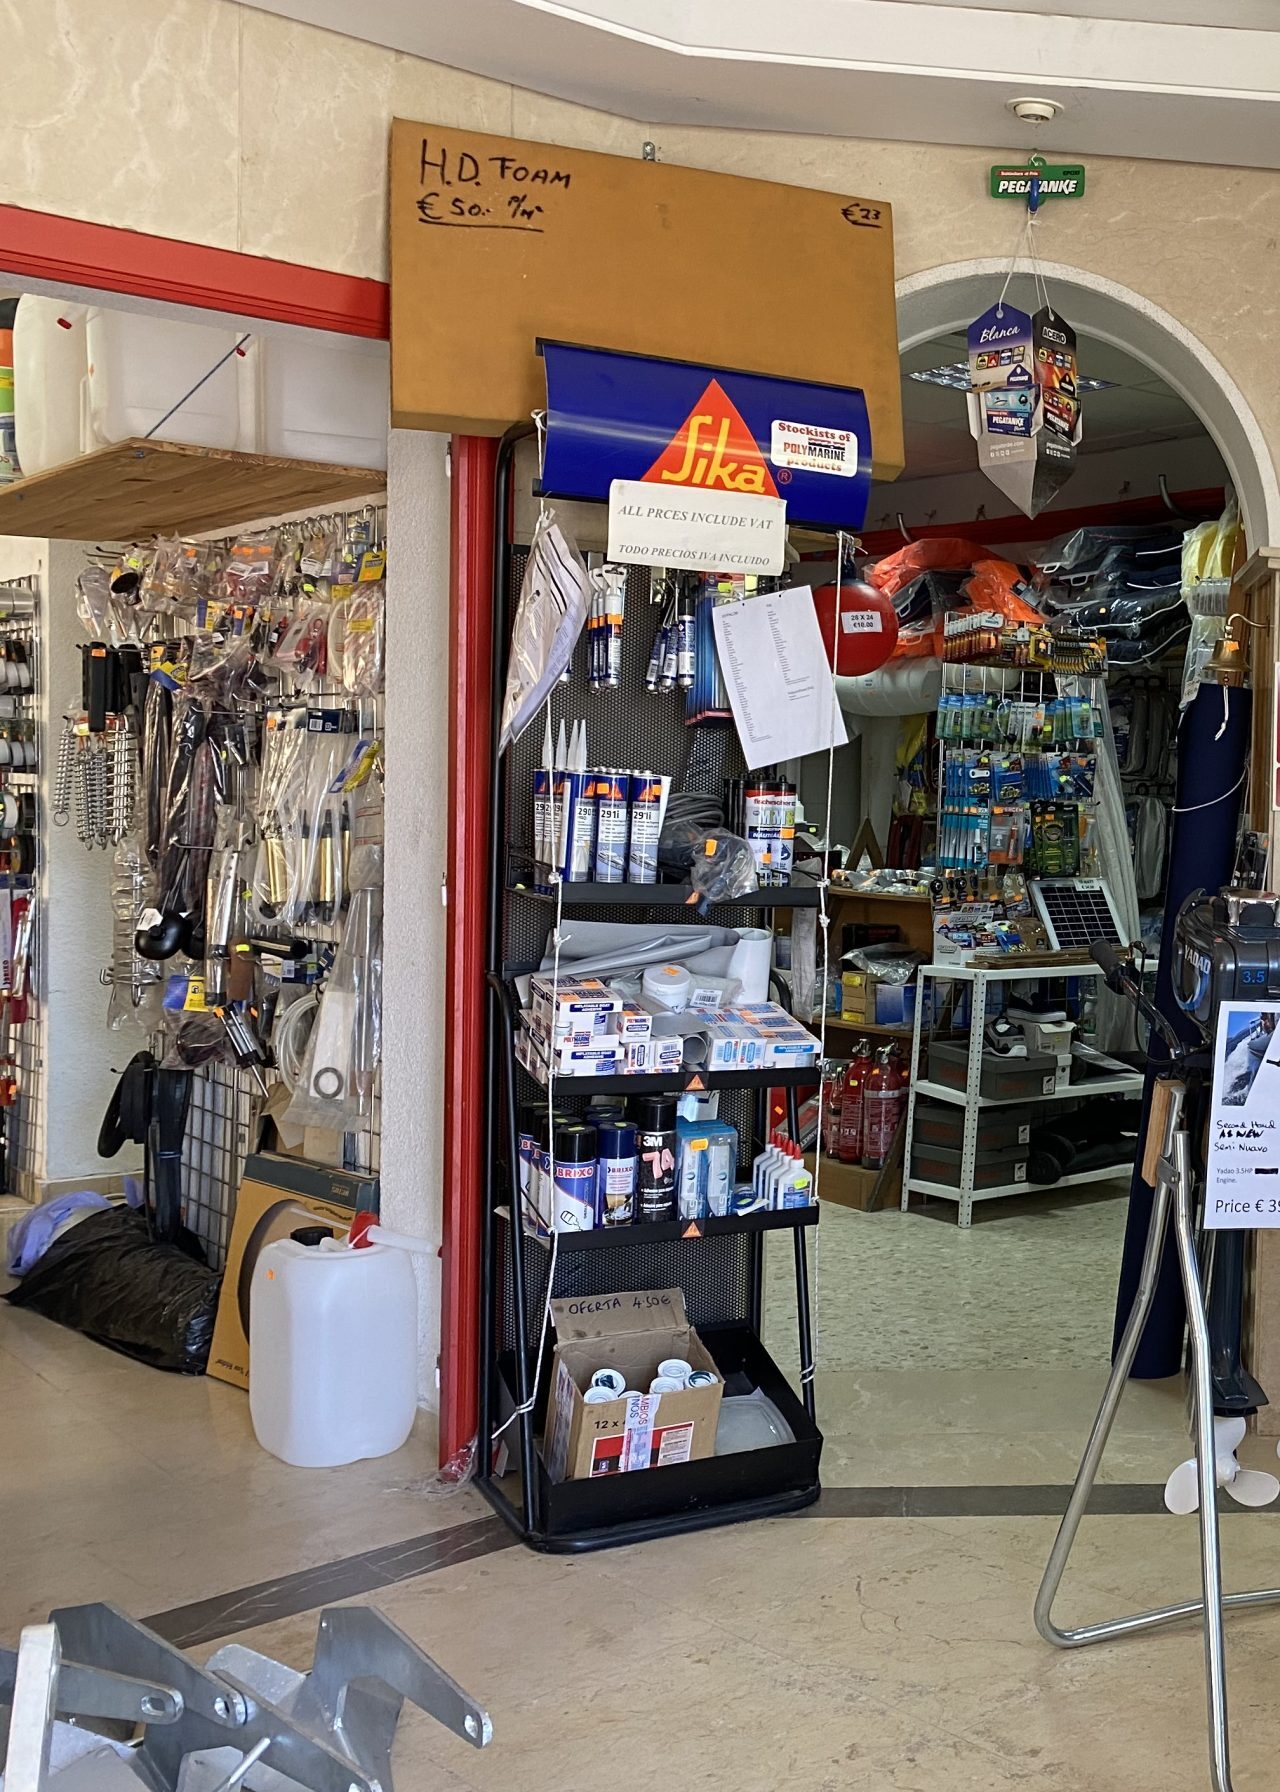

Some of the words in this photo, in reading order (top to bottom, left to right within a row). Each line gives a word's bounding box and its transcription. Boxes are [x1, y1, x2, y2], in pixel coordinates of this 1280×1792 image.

[420, 138, 481, 187] H.D.
[488, 157, 571, 189] FOAM
[998, 179, 1078, 195] PEGAANKE
[980, 326, 1020, 344] Blanca
[1042, 326, 1067, 345] ACERO
[778, 422, 836, 441] Stockists
[839, 433, 852, 443] of
[661, 415, 766, 494] Sika
[783, 442, 846, 462] POLYMARINE
[786, 457, 842, 472] products
[618, 505, 644, 517] ALL
[647, 507, 689, 522] PRCES
[690, 512, 747, 528] INCLUDE
[749, 518, 773, 530] VAT
[618, 544, 649, 555] TODO
[651, 547, 698, 560] PRECIOS
[699, 551, 717, 562] IVA
[719, 553, 770, 566] INCLUIDO
[1184, 945, 1212, 974] YADAO
[1242, 971, 1266, 984] 3.5
[642, 1135, 663, 1147] 3M
[1236, 1128, 1265, 1139] NEW
[556, 1166, 594, 1179] BRIXO
[611, 1166, 634, 1174] BRIXO
[1216, 1167, 1235, 1175] Yadao
[1235, 1167, 1253, 1175] 3.5HP
[1215, 1198, 1251, 1213] Price
[1254, 1199, 1265, 1213] €
[568, 1298, 622, 1315] OFERTA
[594, 1420, 609, 1429] 12
